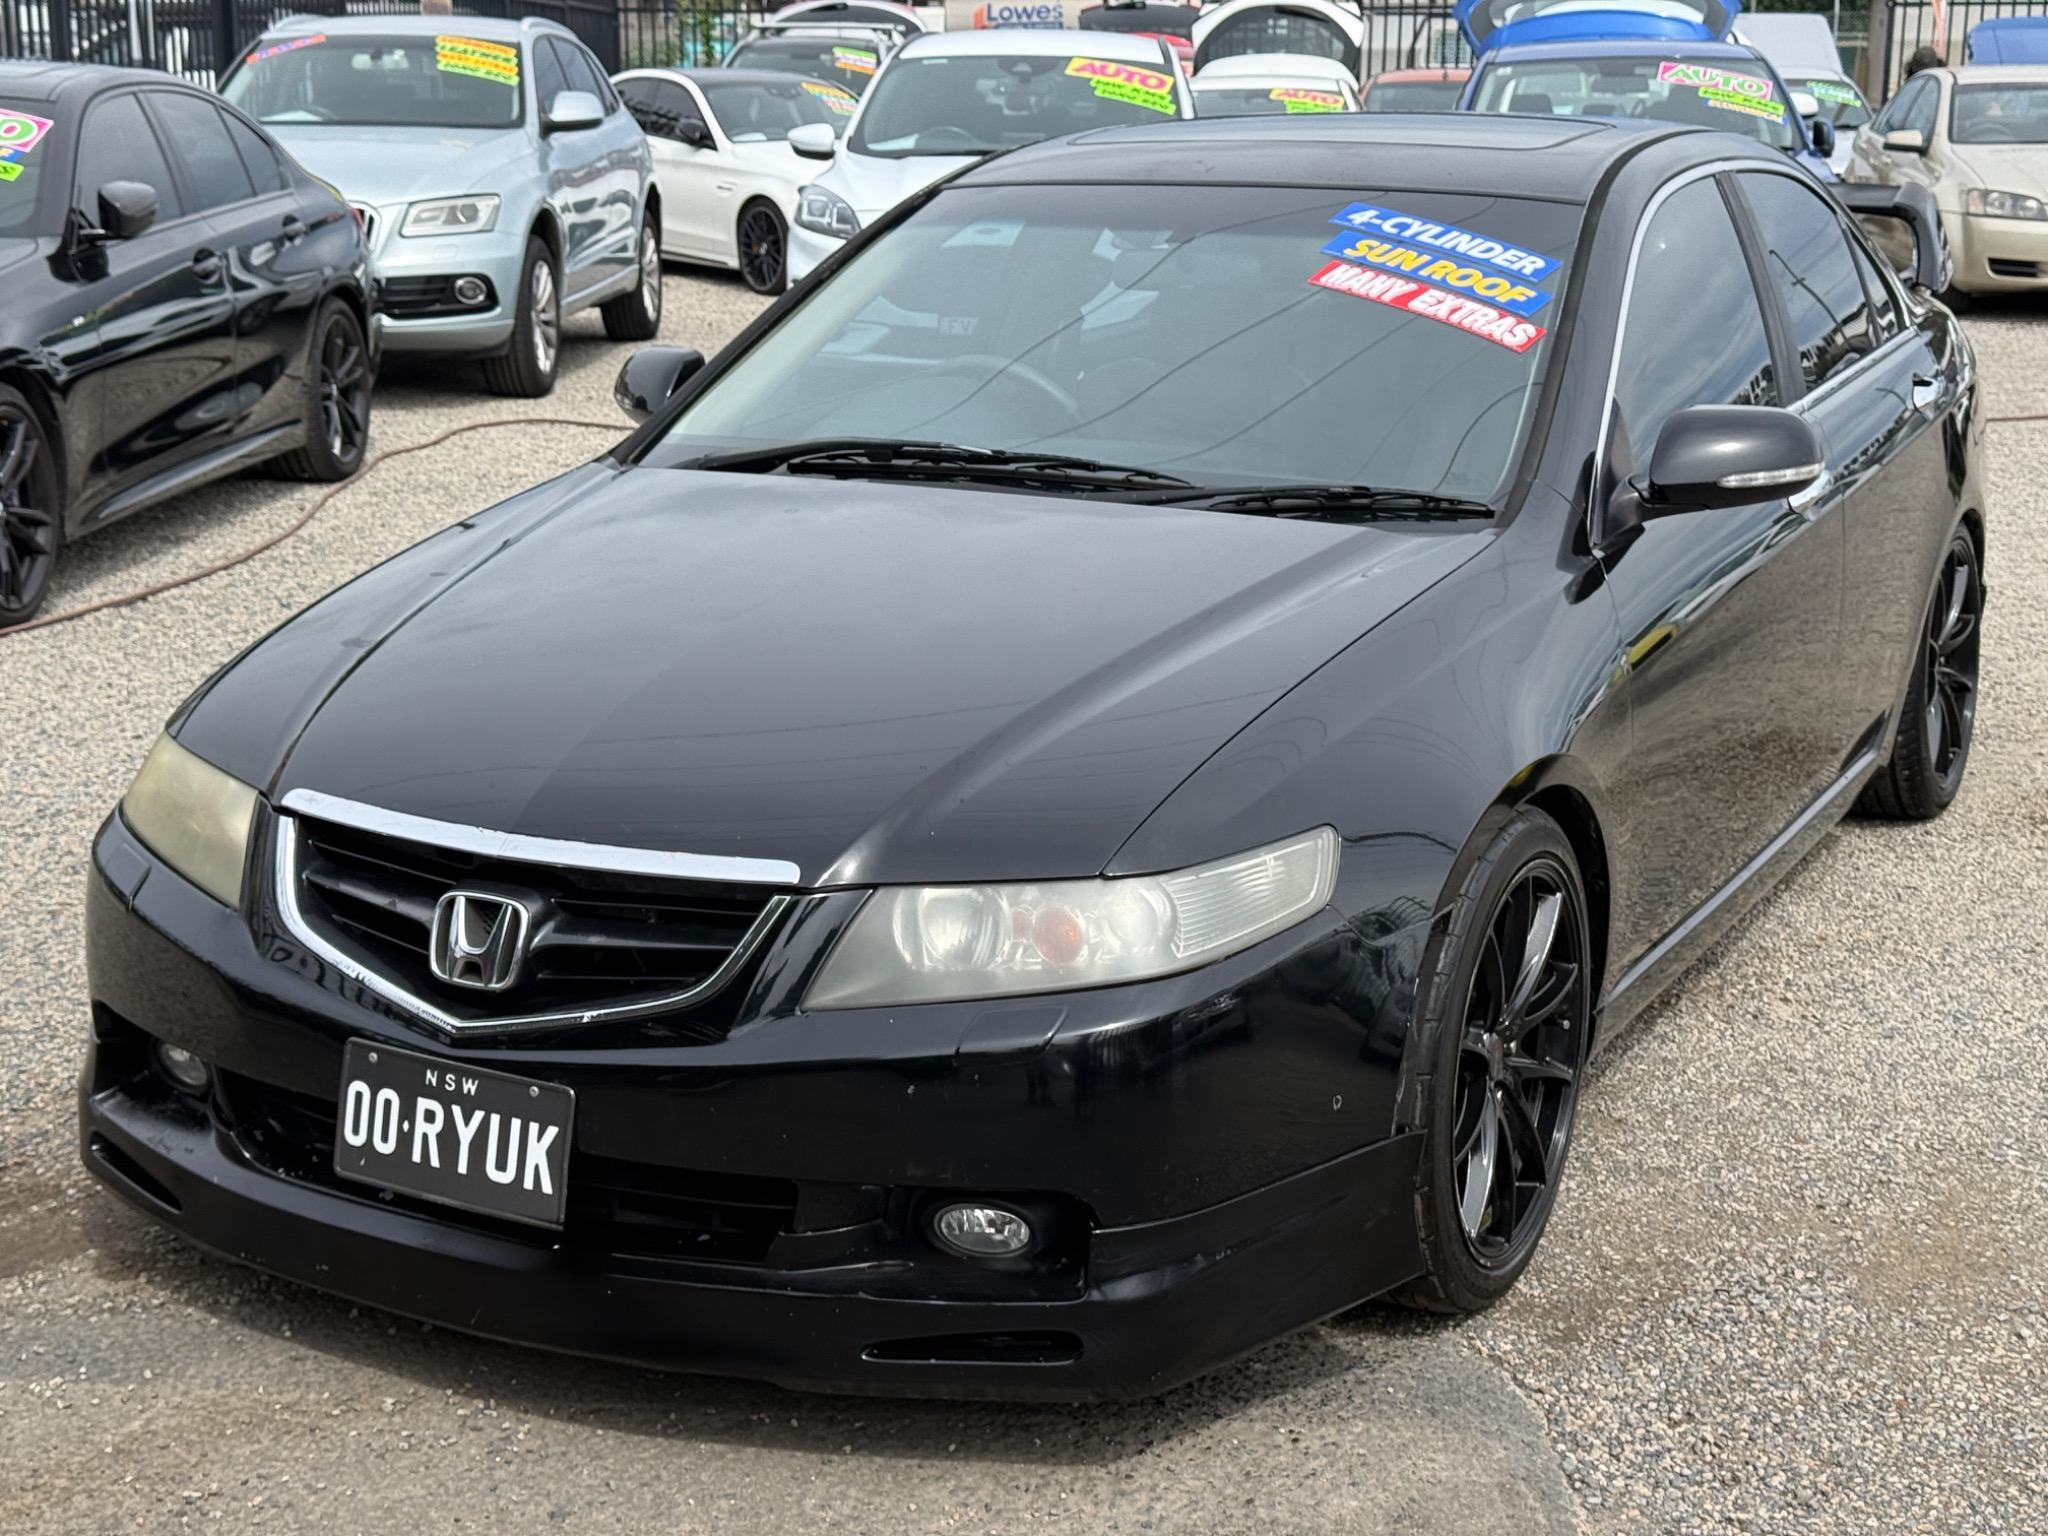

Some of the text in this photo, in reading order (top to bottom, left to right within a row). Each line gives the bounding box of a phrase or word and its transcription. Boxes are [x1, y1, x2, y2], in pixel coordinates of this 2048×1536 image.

[986, 3, 1063, 21] Lowes
[1072, 62, 1168, 91] AUTO
[1664, 63, 1767, 97] AUTO
[1346, 208, 1547, 276] 4-CYLINDER
[1343, 239, 1537, 303] SUN ROOF
[1319, 263, 1538, 347] MANY EXTRAS
[425, 1068, 479, 1096] NSW
